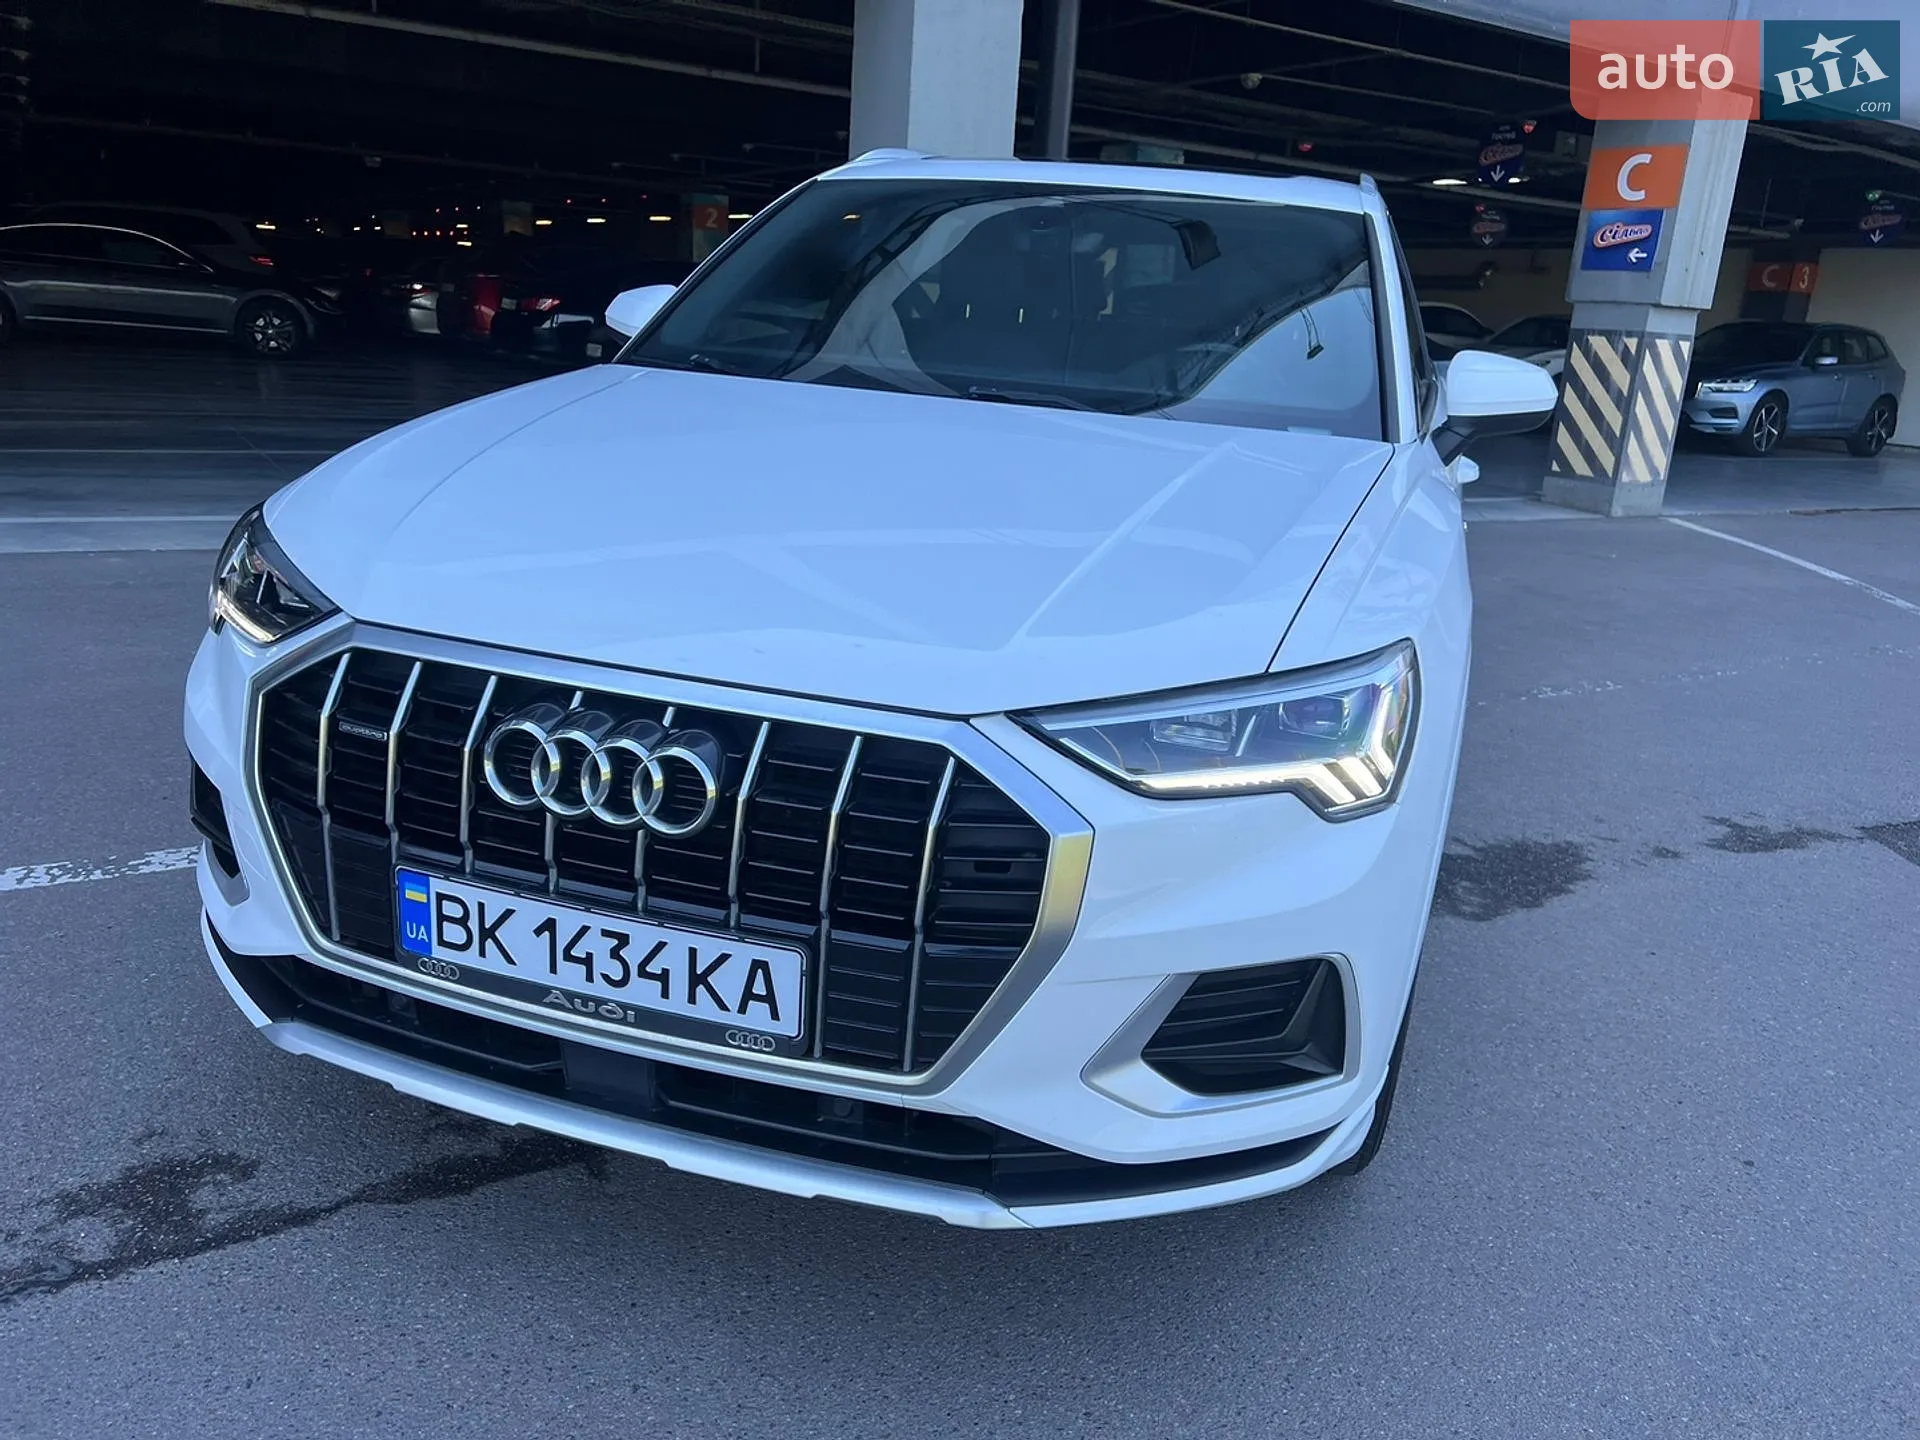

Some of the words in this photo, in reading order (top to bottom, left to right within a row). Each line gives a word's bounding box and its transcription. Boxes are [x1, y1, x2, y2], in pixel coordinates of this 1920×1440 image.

[1616, 153, 1653, 202] C
[704, 207, 719, 229] 2
[1761, 263, 1780, 288] C
[1799, 266, 1810, 289] 3
[405, 920, 429, 943] UA
[435, 891, 518, 967] BK
[532, 916, 671, 1001] 1434
[686, 945, 782, 1022] KA
[542, 989, 636, 1024] Audi
